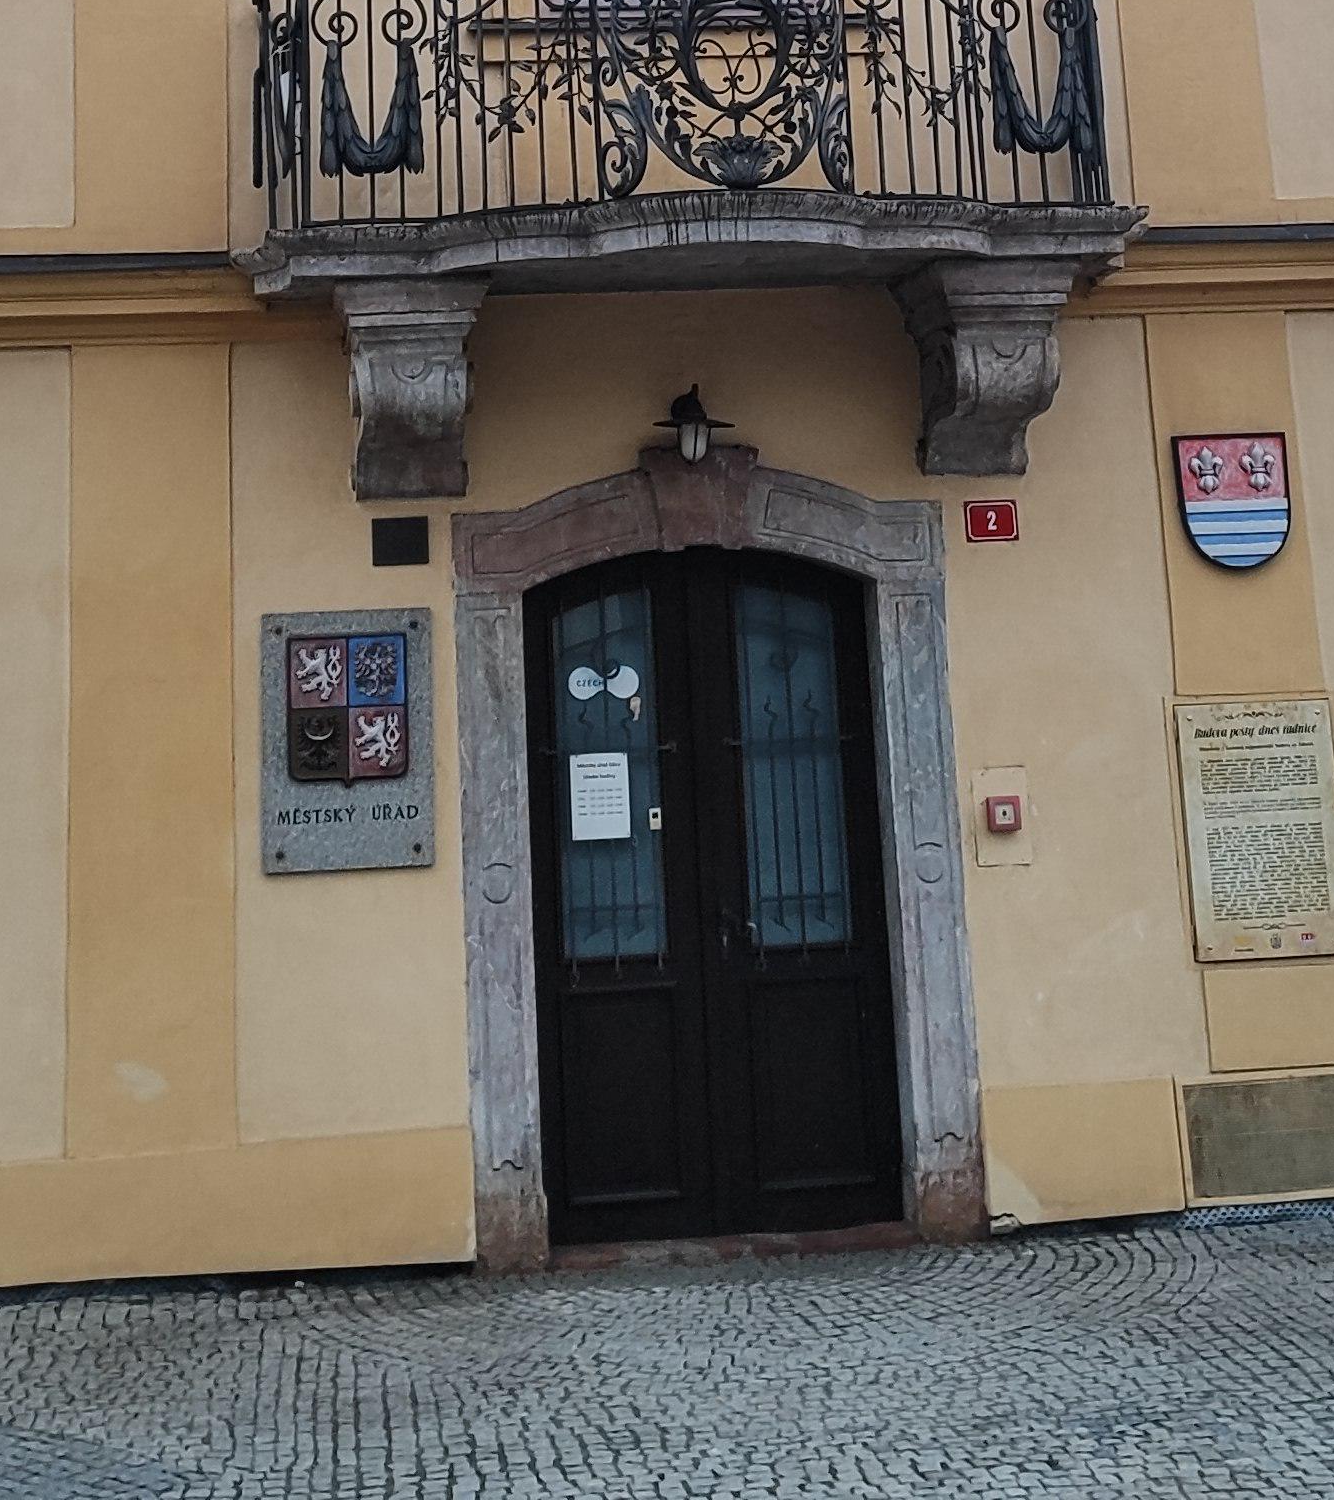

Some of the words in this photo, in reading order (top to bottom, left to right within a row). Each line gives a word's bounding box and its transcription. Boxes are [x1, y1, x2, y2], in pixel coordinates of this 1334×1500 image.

[987, 510, 997, 531] 2
[277, 803, 357, 826] MĚSTSKÝ
[371, 802, 419, 821] ÚŘAD
